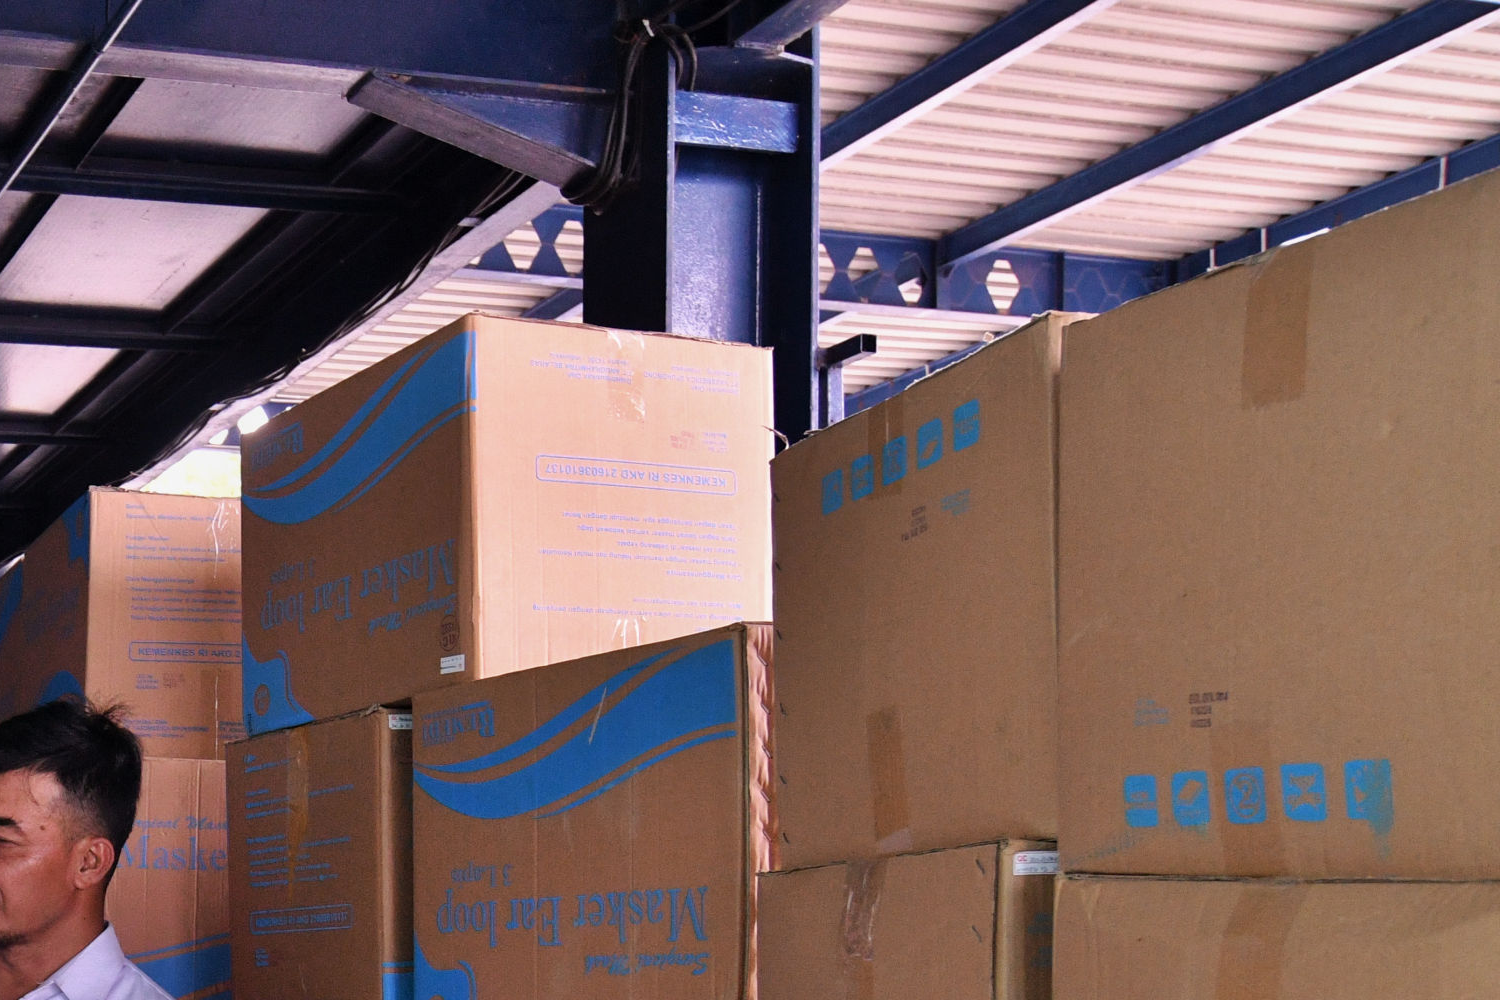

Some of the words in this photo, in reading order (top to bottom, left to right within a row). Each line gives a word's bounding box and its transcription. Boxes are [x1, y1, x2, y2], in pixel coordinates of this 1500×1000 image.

[621, 469, 645, 480] AKD
[649, 471, 659, 482] RI
[663, 473, 726, 488] KEMENKES
[359, 538, 456, 604] Masker
[260, 589, 305, 633] loop
[311, 575, 353, 622] Ear
[117, 834, 228, 871] Maske
[436, 888, 498, 949] loop
[505, 895, 563, 947] Ear
[573, 885, 709, 944] Masker
